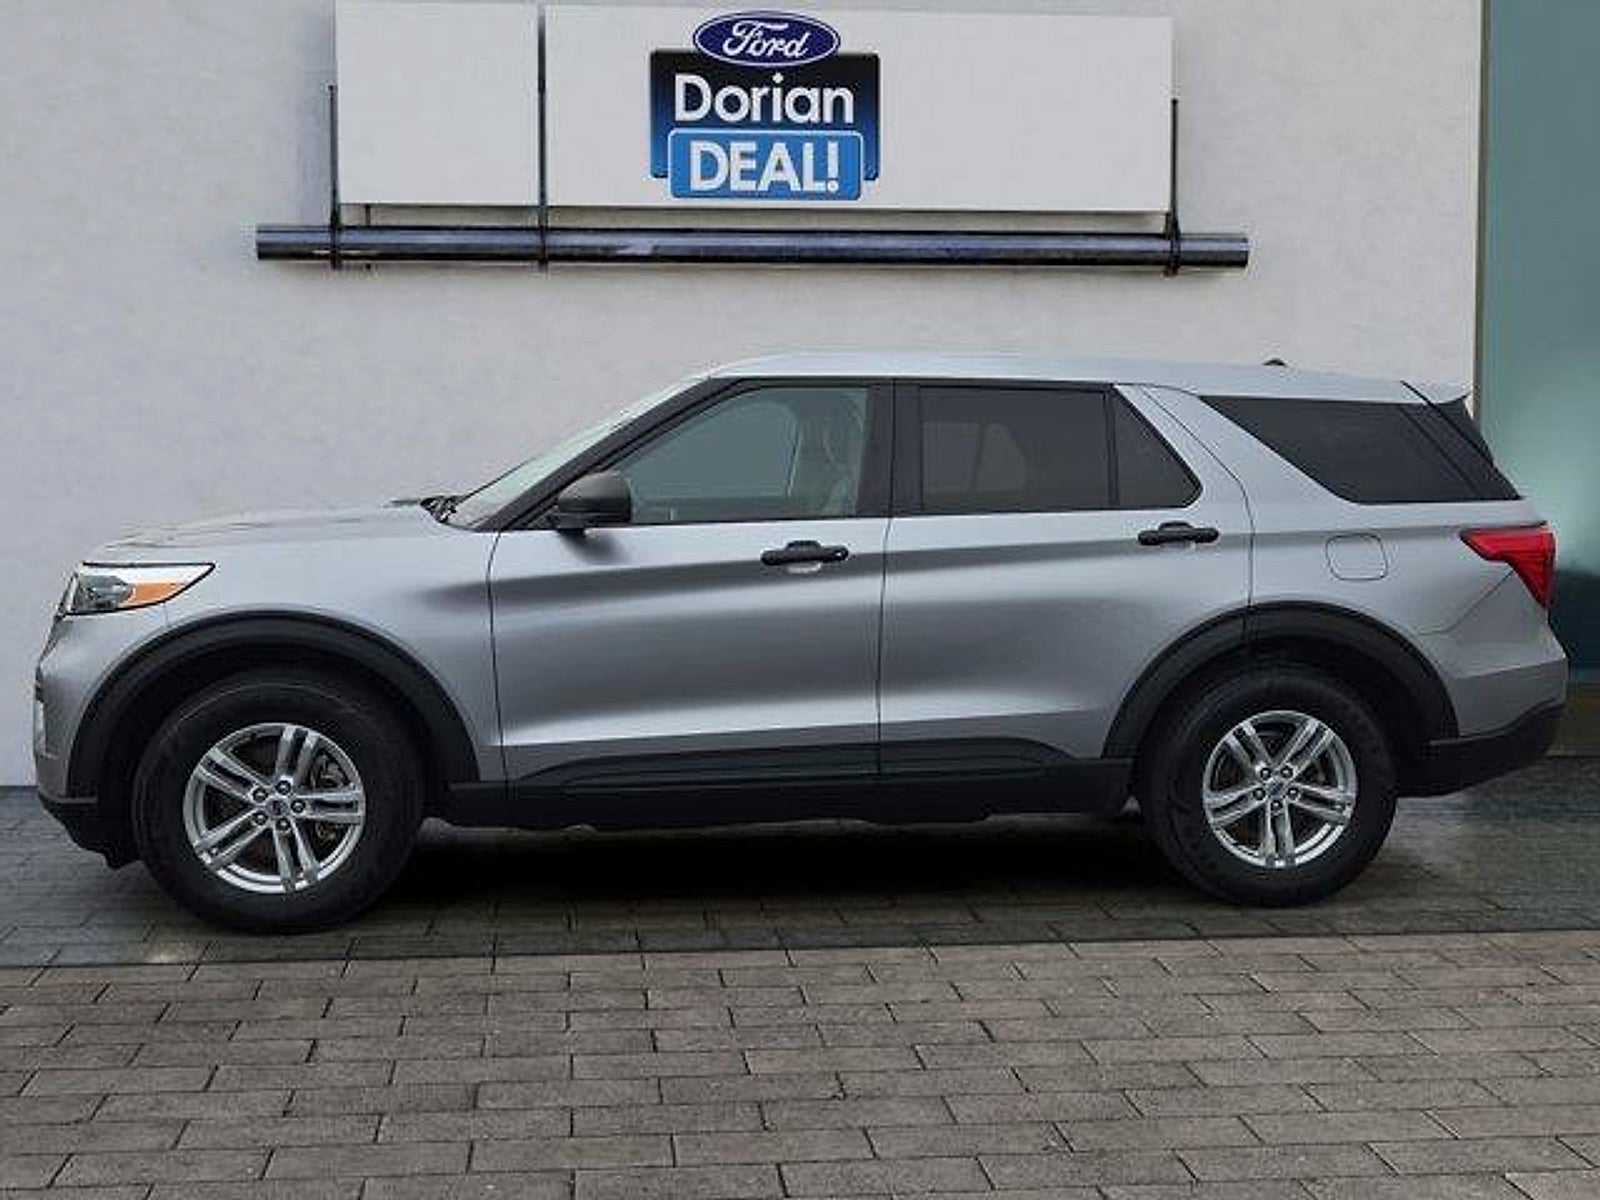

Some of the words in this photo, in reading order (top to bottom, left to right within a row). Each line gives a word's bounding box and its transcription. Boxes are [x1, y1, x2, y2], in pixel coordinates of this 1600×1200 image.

[722, 19, 812, 58] Ford
[674, 72, 854, 124] Dorian
[689, 140, 840, 193] DEAL!
